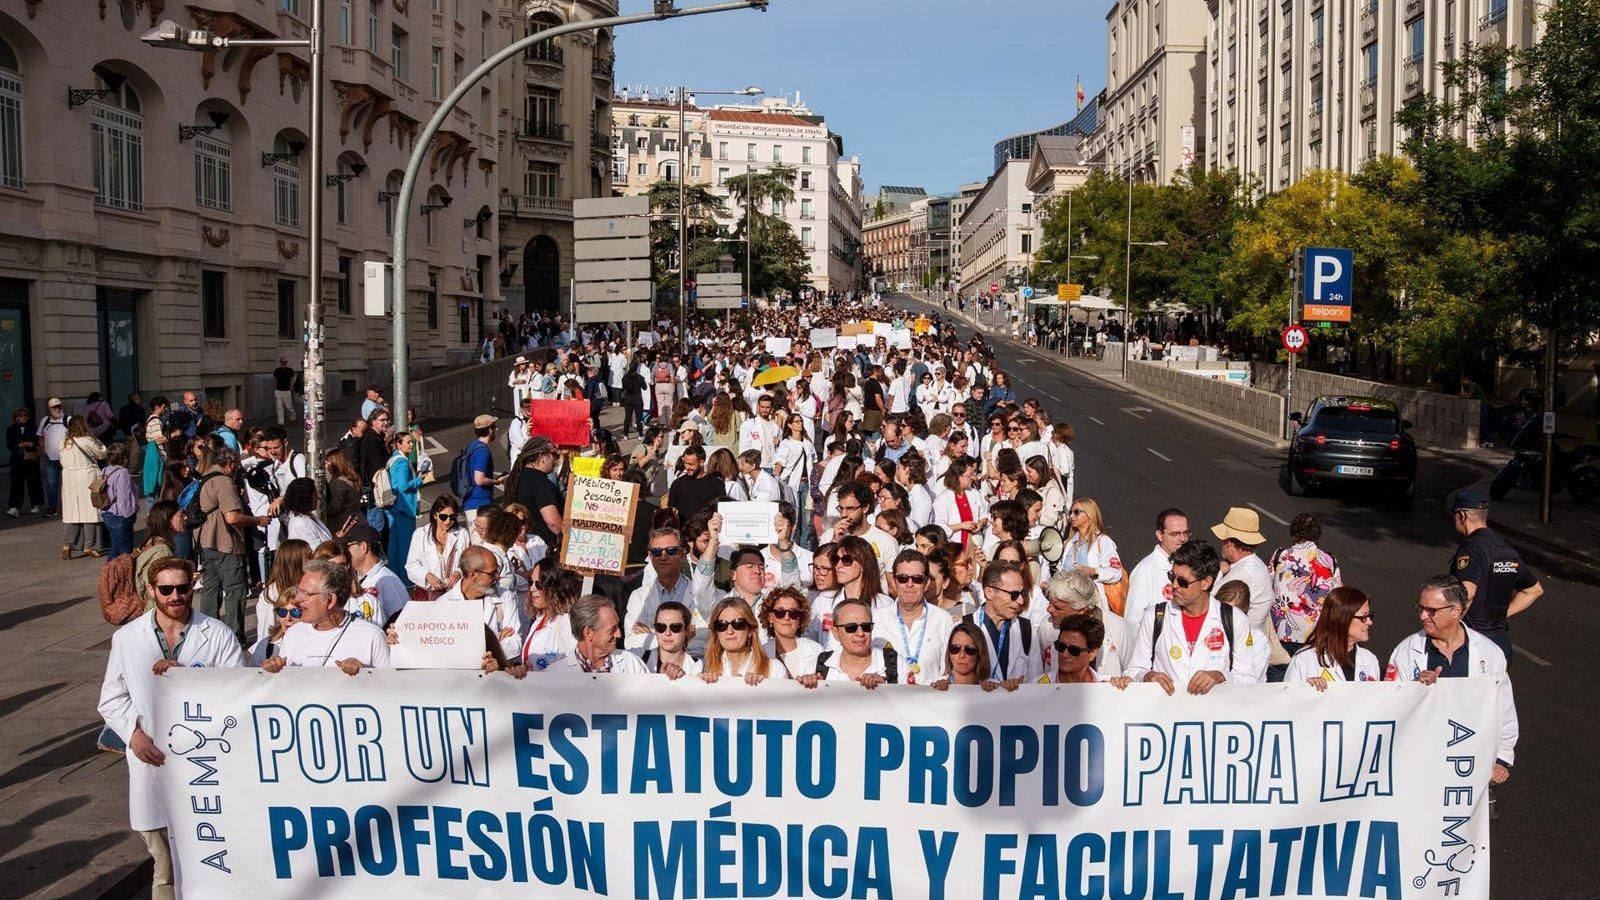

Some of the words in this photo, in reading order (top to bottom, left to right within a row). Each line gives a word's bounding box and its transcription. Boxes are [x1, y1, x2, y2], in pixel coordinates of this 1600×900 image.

[1313, 255, 1343, 300] P
[1329, 293, 1343, 301] 24h
[1311, 307, 1344, 316] telpark
[1343, 465, 1359, 475] 8072
[584, 501, 599, 512] NO
[572, 518, 624, 534] MALTRATADA
[569, 528, 593, 543] NO
[598, 533, 616, 546] AL
[567, 543, 622, 560] ESTATUTO
[577, 556, 620, 570] MARCO
[403, 622, 416, 631] YO
[417, 622, 447, 631] APOYO
[448, 622, 456, 631] A
[457, 622, 469, 631] MI
[420, 636, 455, 646] MÉDICO
[252, 703, 387, 783] POR
[400, 705, 490, 788] UN
[512, 712, 837, 799] ESTATUTO
[864, 723, 1104, 807] PROPIO
[1123, 720, 1299, 807] PARA
[1319, 720, 1397, 803] LA
[269, 796, 609, 897] PROFESIÓN
[633, 801, 895, 900] MÉDICA
[918, 829, 960, 900] Y
[982, 820, 1402, 900] FACULTATIVA
